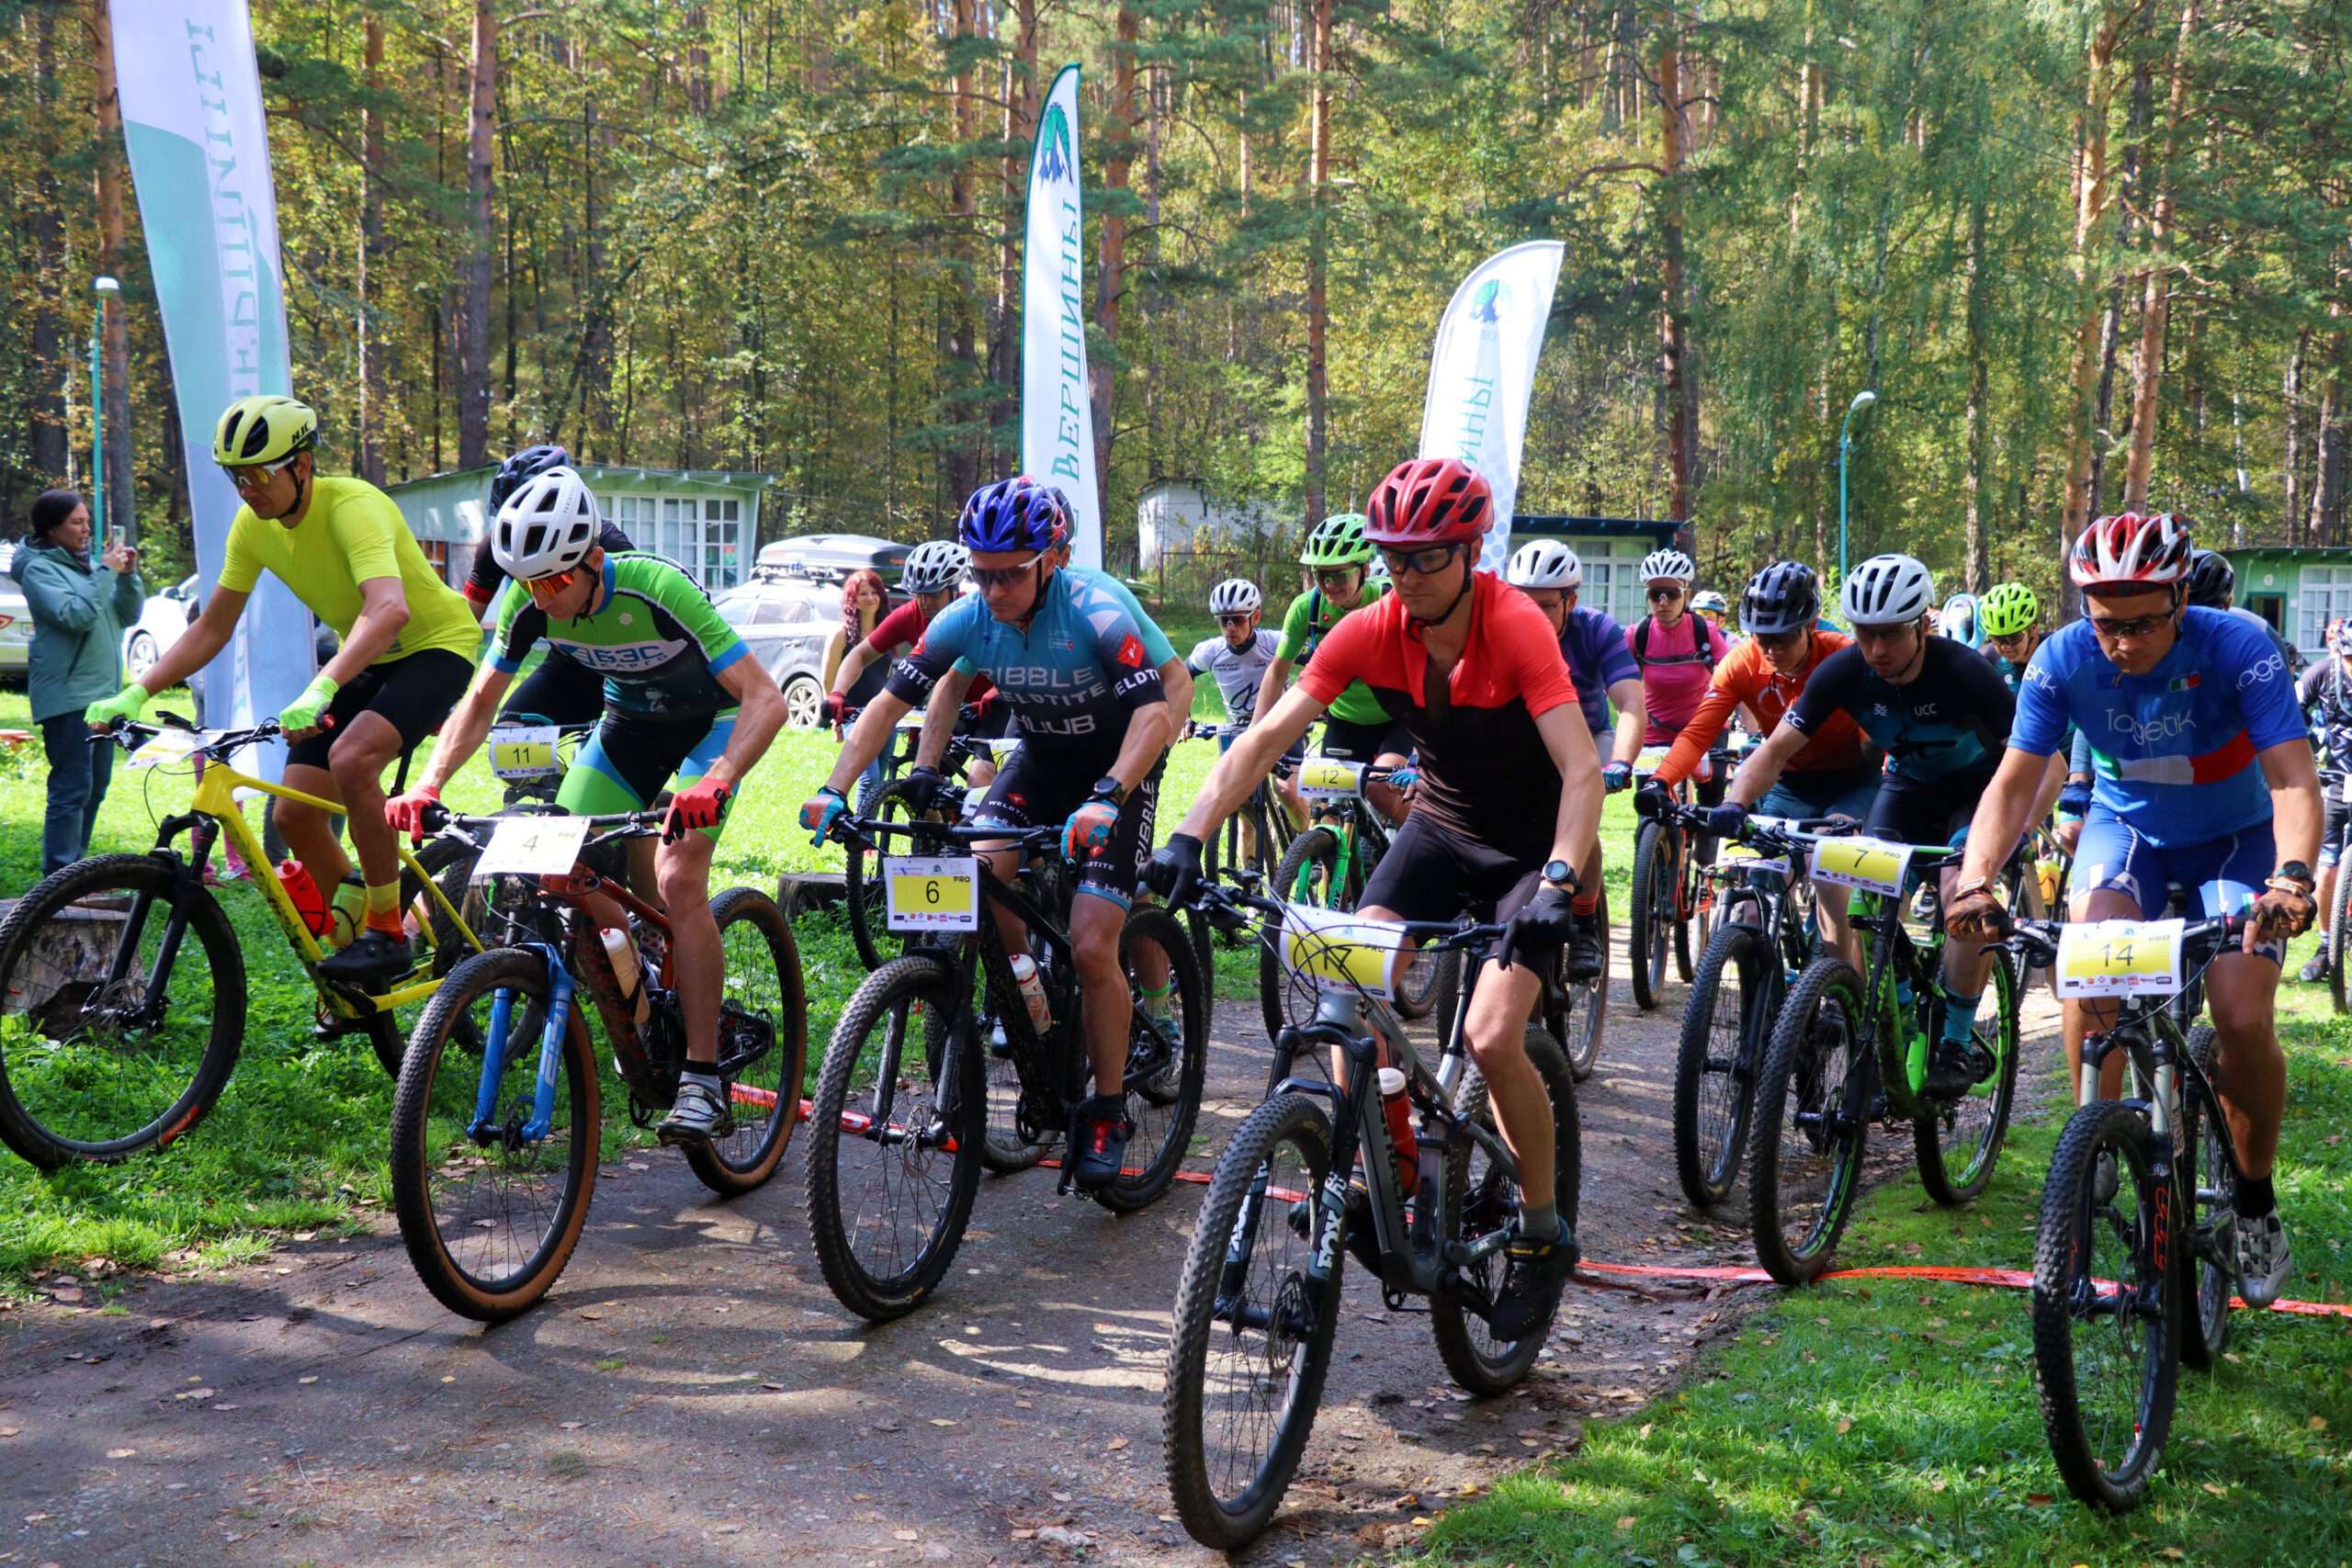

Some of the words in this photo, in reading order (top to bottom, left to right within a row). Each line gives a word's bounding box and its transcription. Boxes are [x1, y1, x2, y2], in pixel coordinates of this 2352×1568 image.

[1051, 199, 1080, 482] ВЕРШИНЫ
[1000, 682, 1105, 705] ELDTITE
[1914, 703, 1938, 716] UCC
[2105, 708, 2197, 745] Tagetik
[513, 747, 530, 764] 11
[1321, 770, 1340, 784] 12
[523, 834, 539, 852] 4
[1853, 848, 1870, 868] 7
[1883, 851, 1901, 859] PRO
[925, 880, 940, 904] 6
[2101, 942, 2134, 967] 14
[1317, 1209, 1343, 1268] FOX
